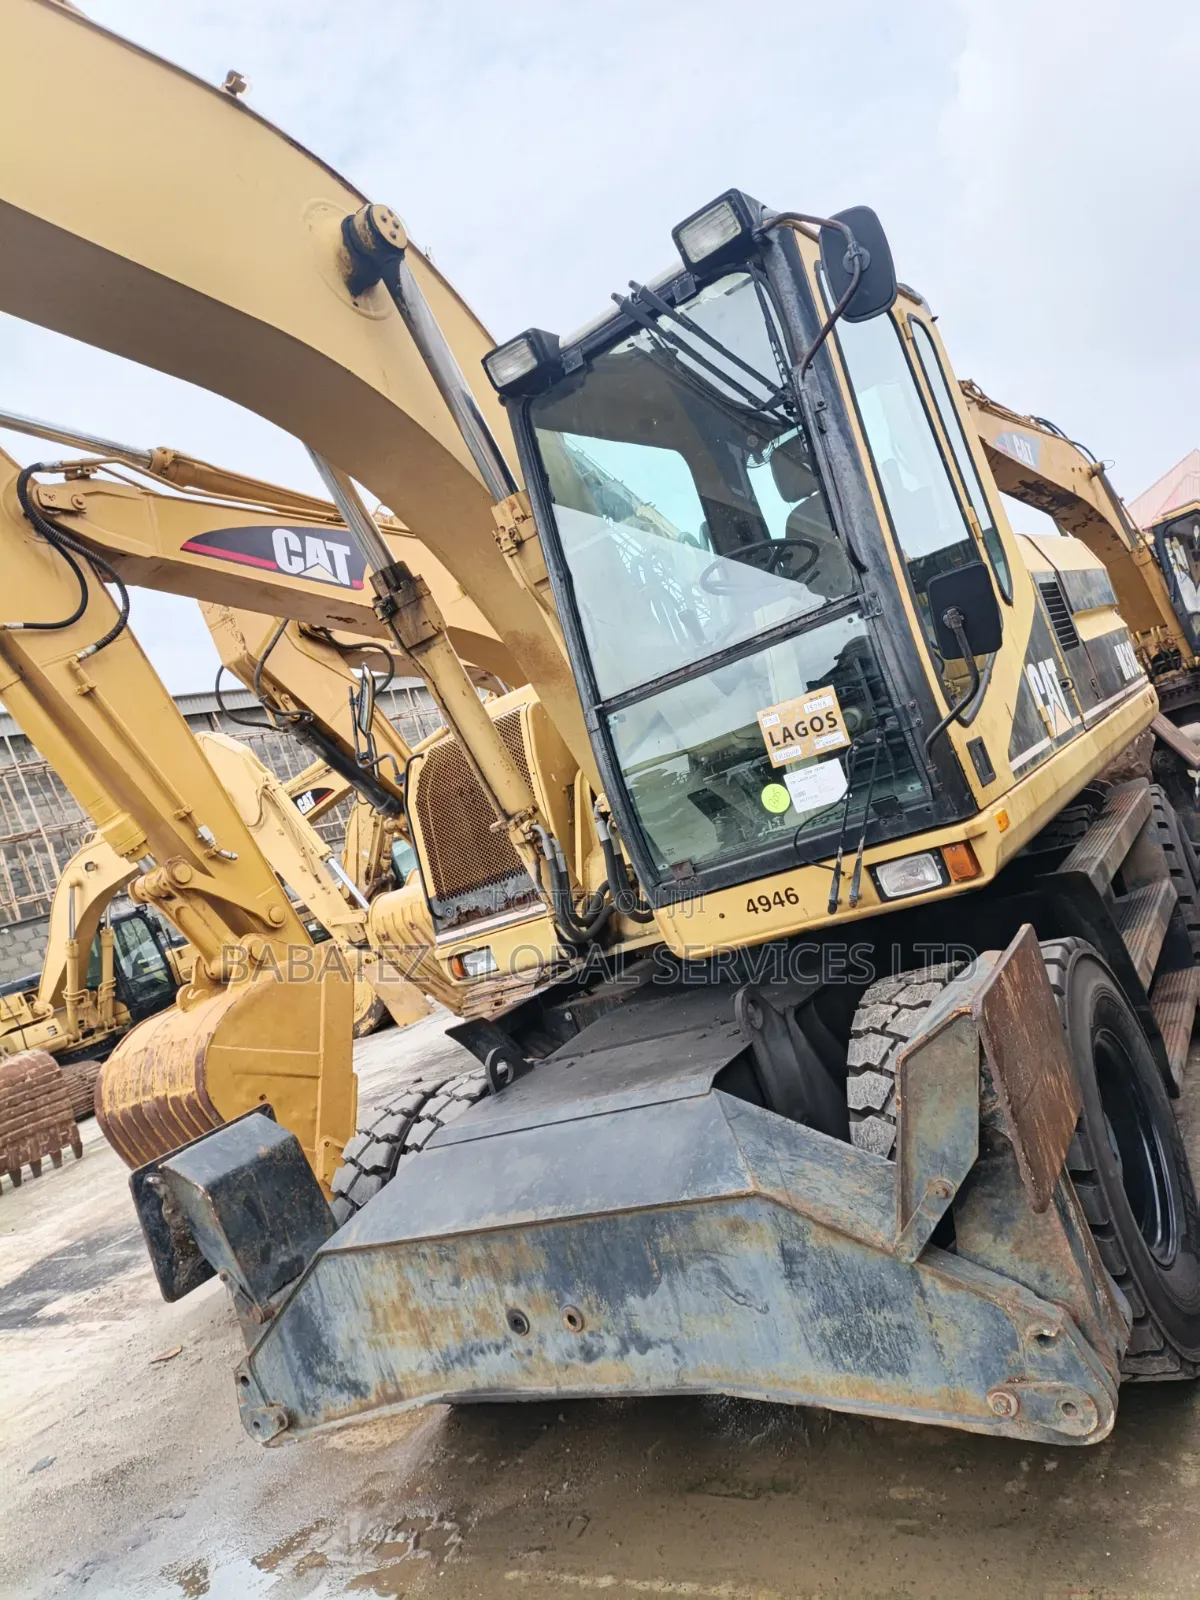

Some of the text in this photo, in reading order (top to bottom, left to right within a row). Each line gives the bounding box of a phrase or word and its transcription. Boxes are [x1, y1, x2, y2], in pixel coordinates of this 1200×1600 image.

[272, 528, 351, 586] CAT
[1026, 657, 1073, 738] CAT
[768, 711, 838, 747] LAGOS
[296, 790, 316, 815] CAT
[746, 887, 799, 915] 4946
